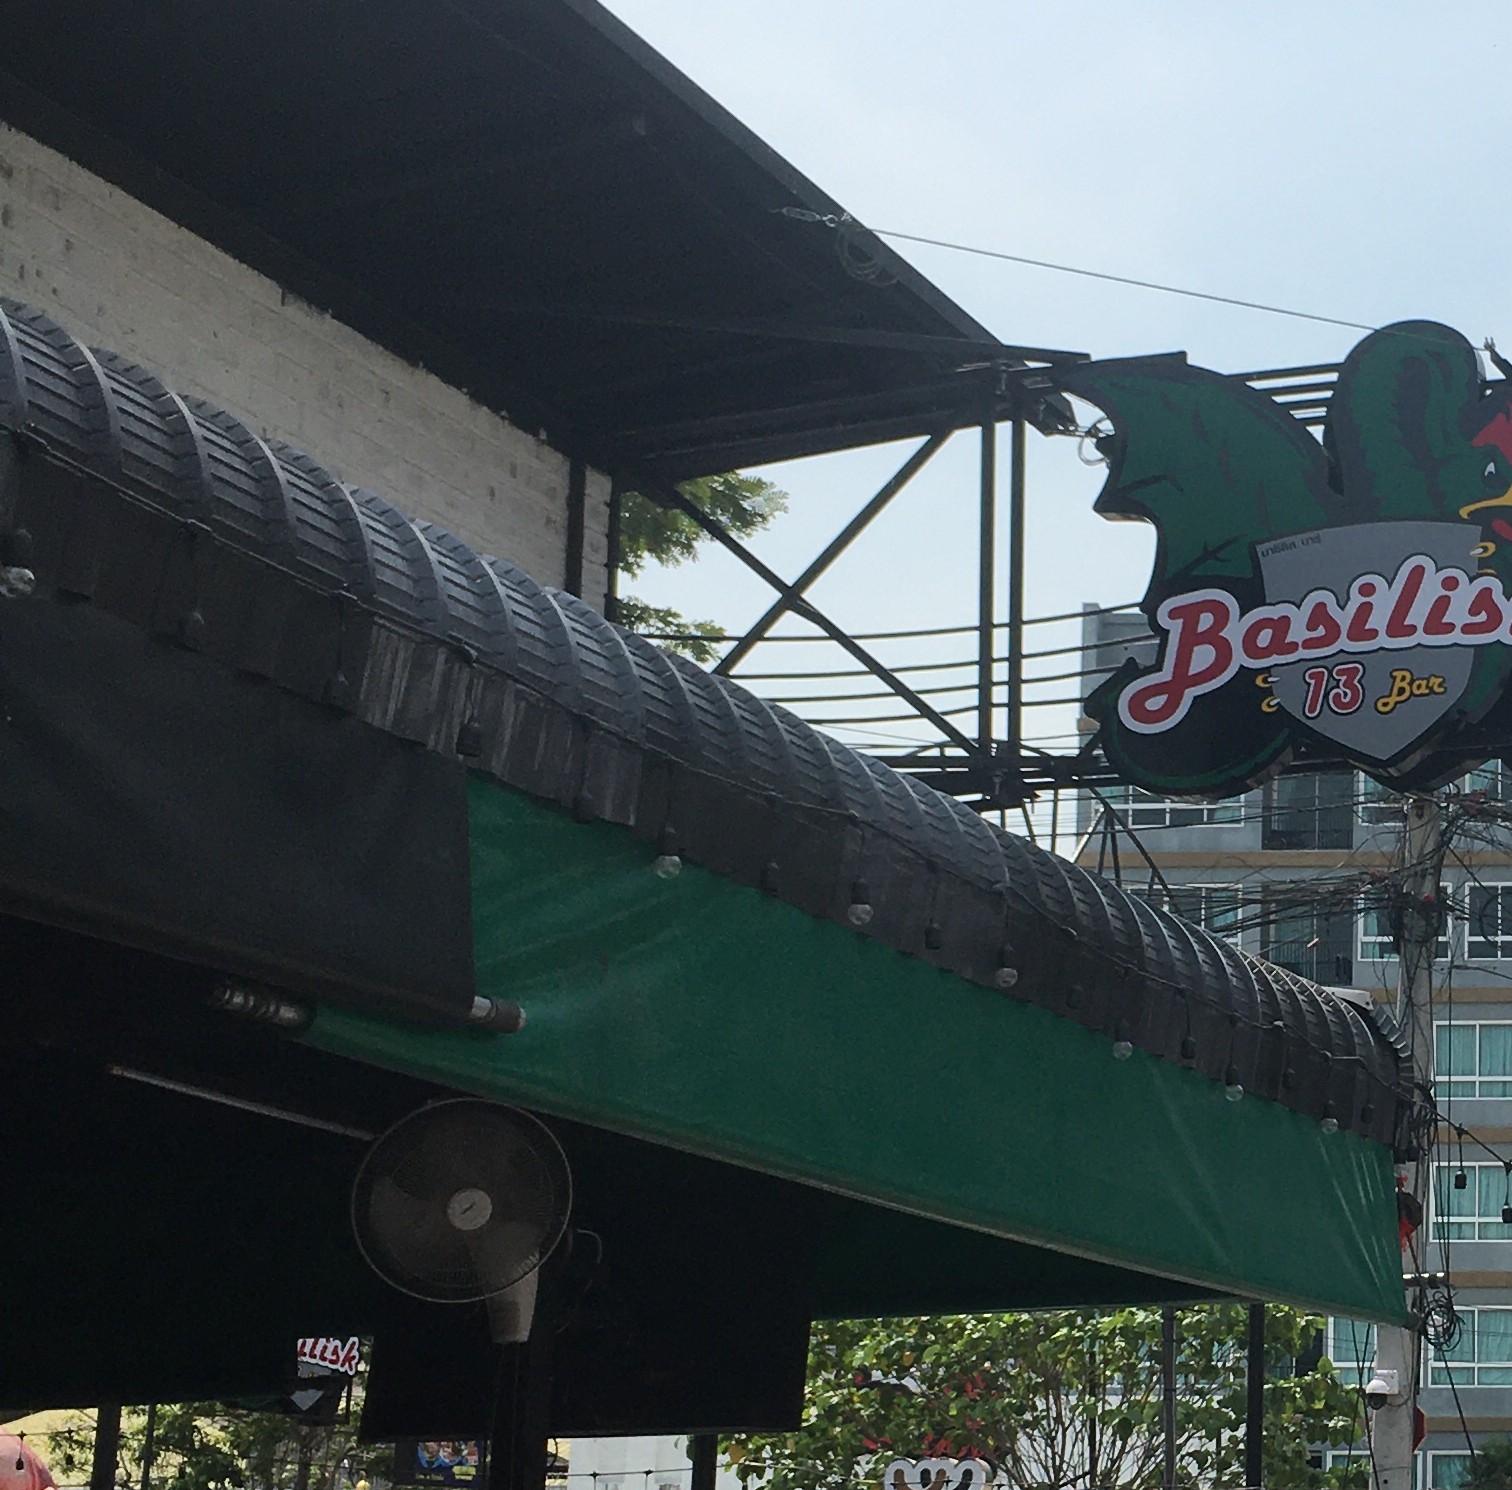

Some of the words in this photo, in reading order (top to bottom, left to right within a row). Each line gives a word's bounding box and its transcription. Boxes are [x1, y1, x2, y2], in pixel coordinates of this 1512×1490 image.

[1303, 663, 1364, 718] 13
[1374, 669, 1447, 714] Bar
[298, 1337, 359, 1375] ilisk
